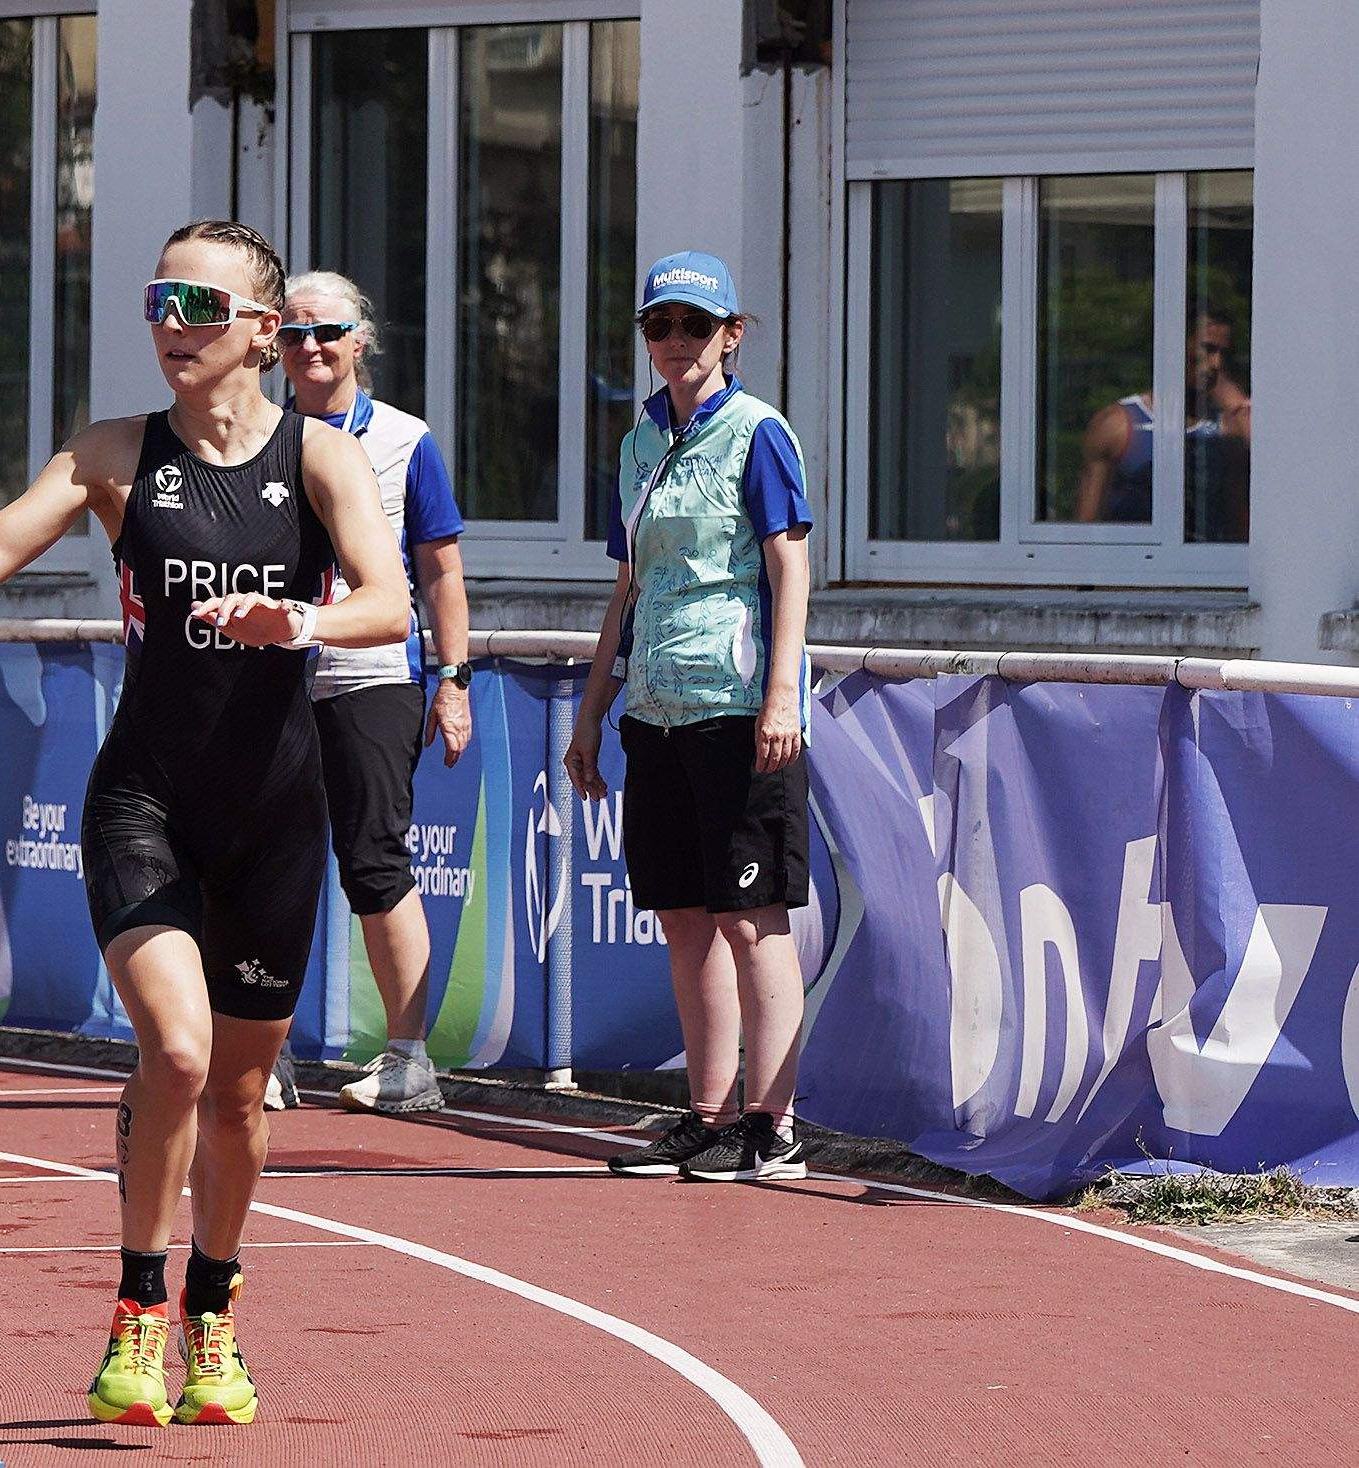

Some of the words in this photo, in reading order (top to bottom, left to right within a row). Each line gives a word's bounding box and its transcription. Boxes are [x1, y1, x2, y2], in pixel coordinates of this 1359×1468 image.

[653, 267, 719, 290] Multisport
[164, 558, 287, 600] PRICE
[22, 794, 39, 830] Be
[39, 803, 67, 839] your
[6, 831, 84, 880] extraordinary
[420, 824, 457, 862] your
